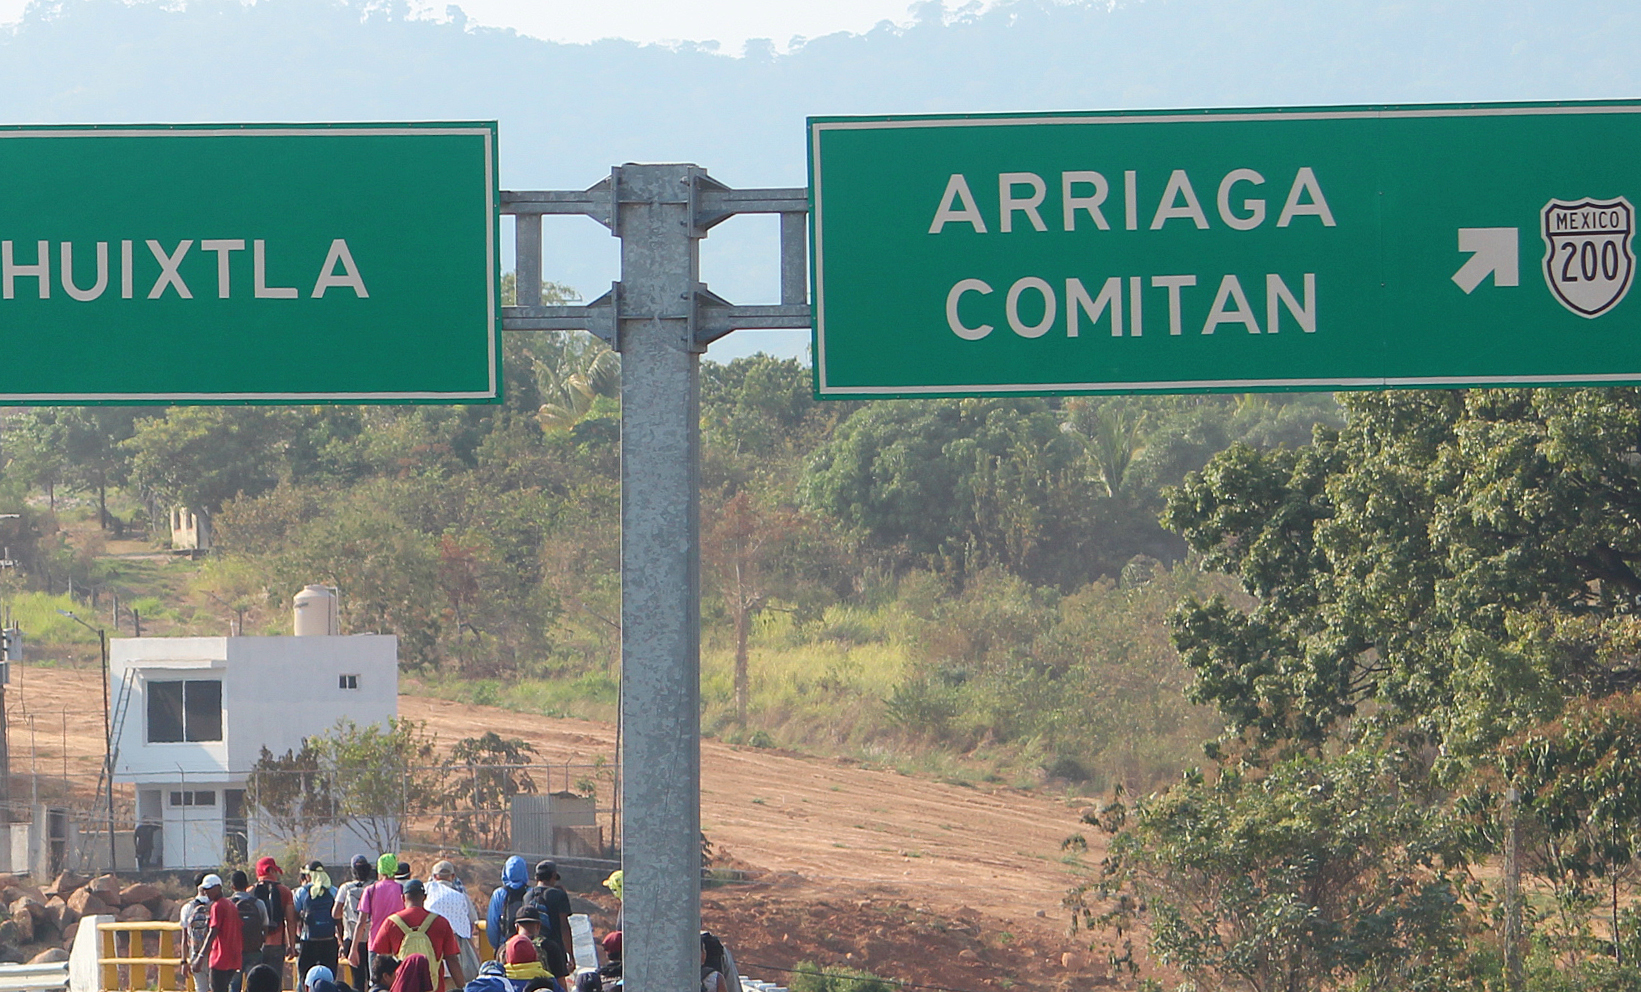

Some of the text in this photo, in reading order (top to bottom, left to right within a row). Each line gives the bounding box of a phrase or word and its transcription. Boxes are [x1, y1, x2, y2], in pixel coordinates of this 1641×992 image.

[928, 166, 1336, 234] ARRIAGA
[1556, 210, 1620, 231] MEXICO
[1, 238, 370, 302] HUIXTLA
[1560, 240, 1619, 282] 200
[945, 272, 1317, 341] COMITAN
